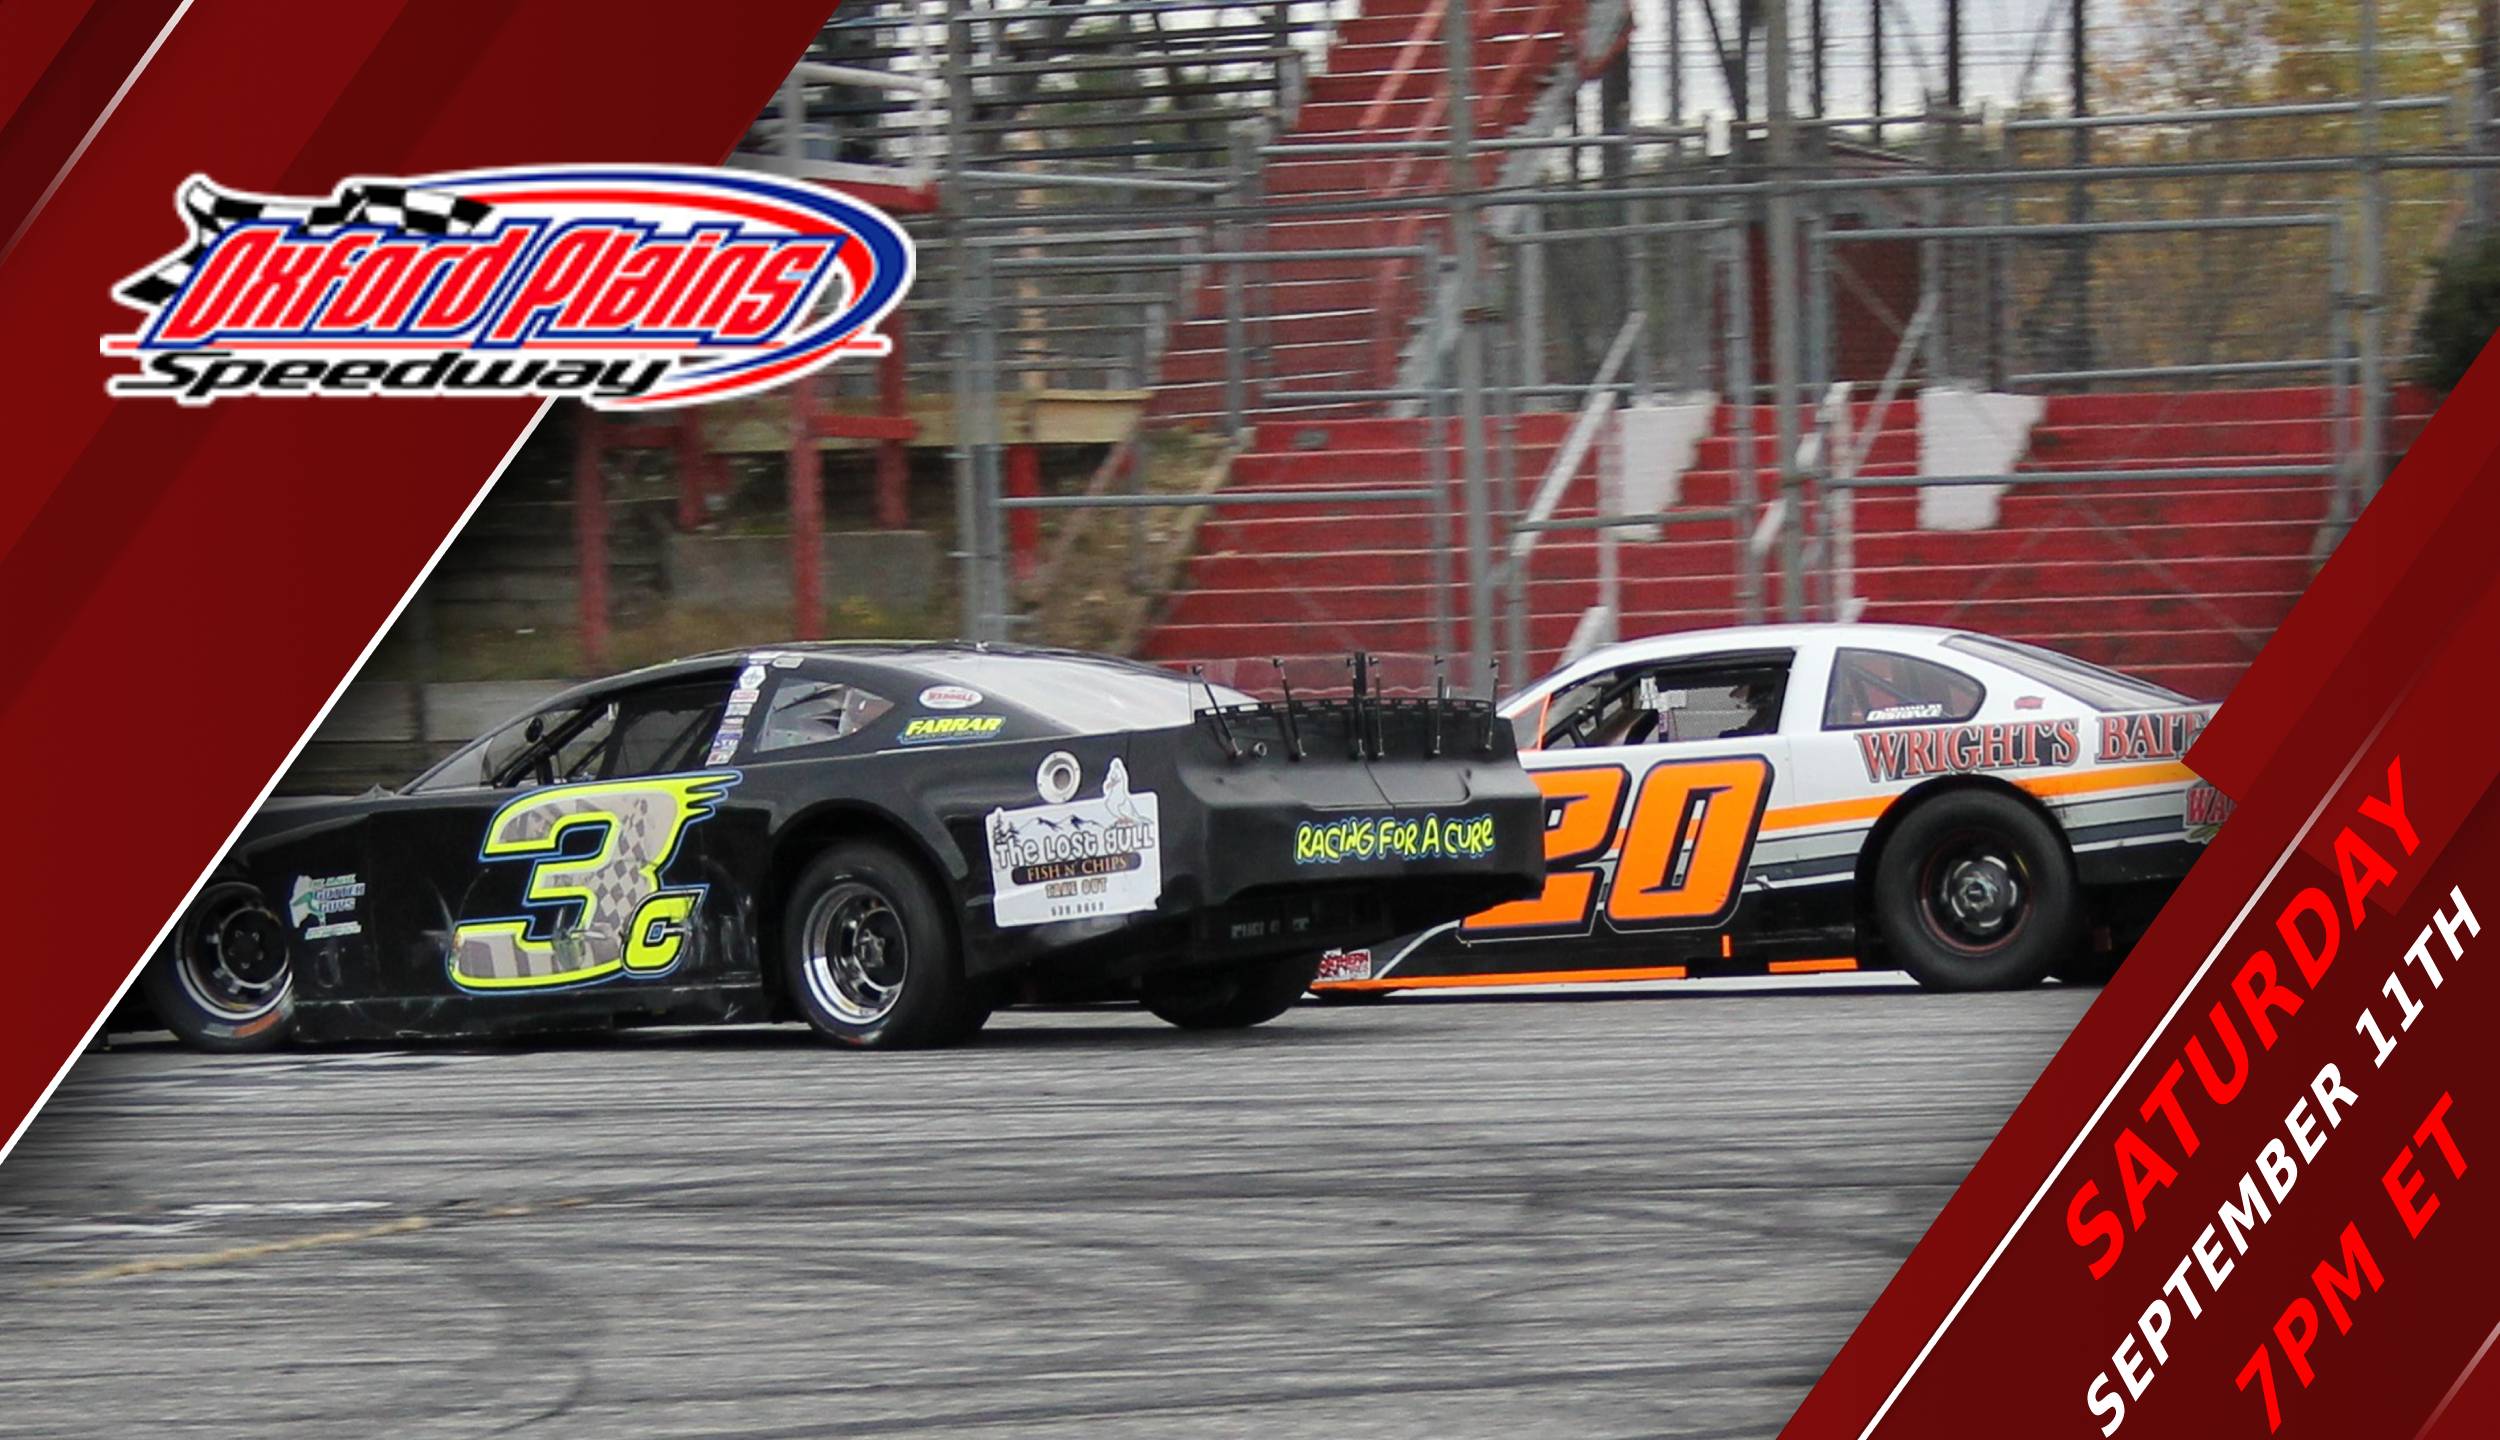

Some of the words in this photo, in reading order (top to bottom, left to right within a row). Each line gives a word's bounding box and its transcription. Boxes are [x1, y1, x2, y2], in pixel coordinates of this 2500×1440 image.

[905, 718, 1002, 736] FARRAR
[1855, 719, 2080, 783] WRIGHT'S
[2185, 786, 2237, 825] WA
[1296, 819, 1376, 862] RACING
[1379, 818, 1418, 858] FOR
[1421, 815, 1440, 855] A
[1456, 755, 1774, 943] 20
[1027, 865, 1060, 882] FISH
[1082, 856, 1127, 874] CHIPS
[1081, 877, 1108, 895] OUT
